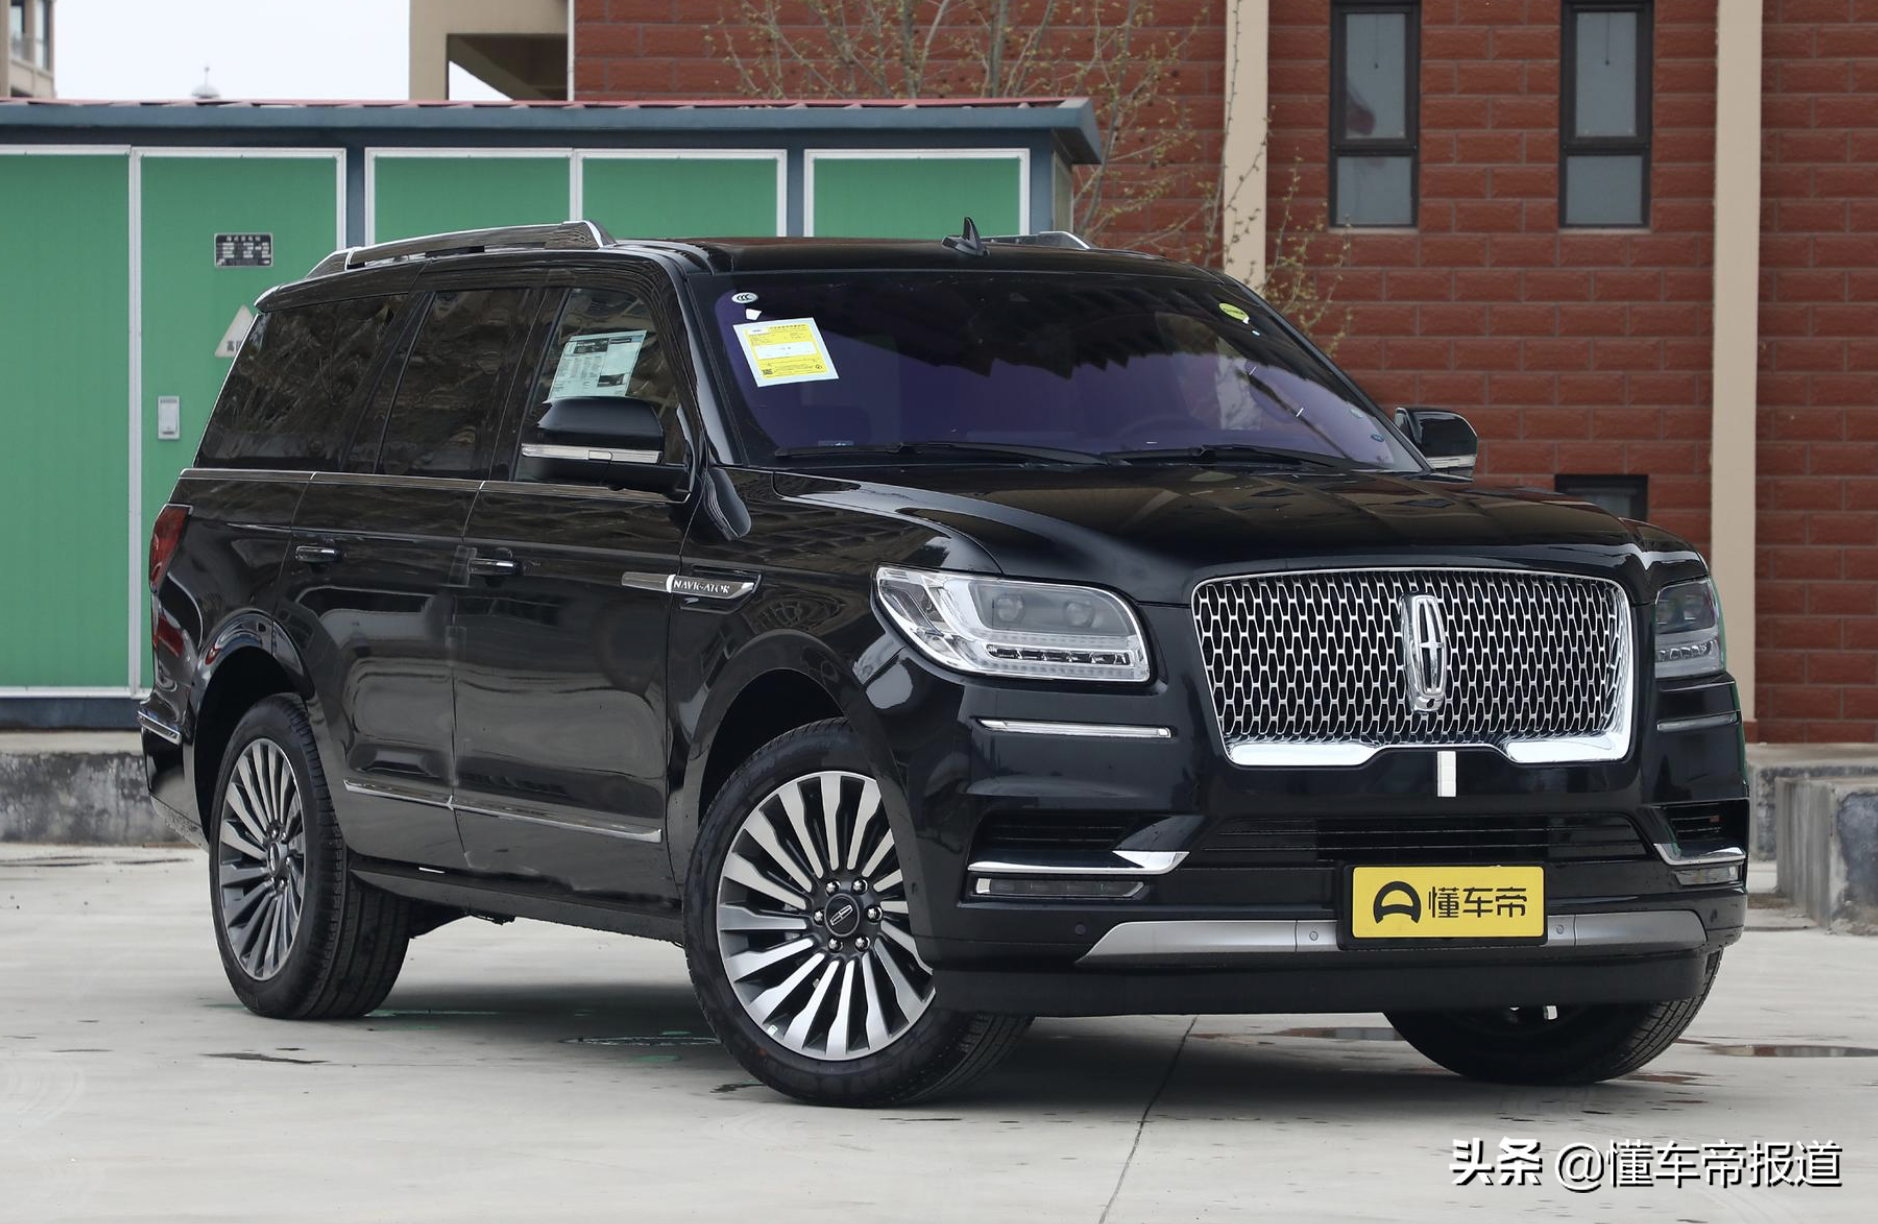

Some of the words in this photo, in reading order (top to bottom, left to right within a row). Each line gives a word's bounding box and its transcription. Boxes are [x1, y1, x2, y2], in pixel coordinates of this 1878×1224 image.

[673, 577, 729, 594] NAVIGATOR
[1428, 886, 1528, 918] 懂车帝
